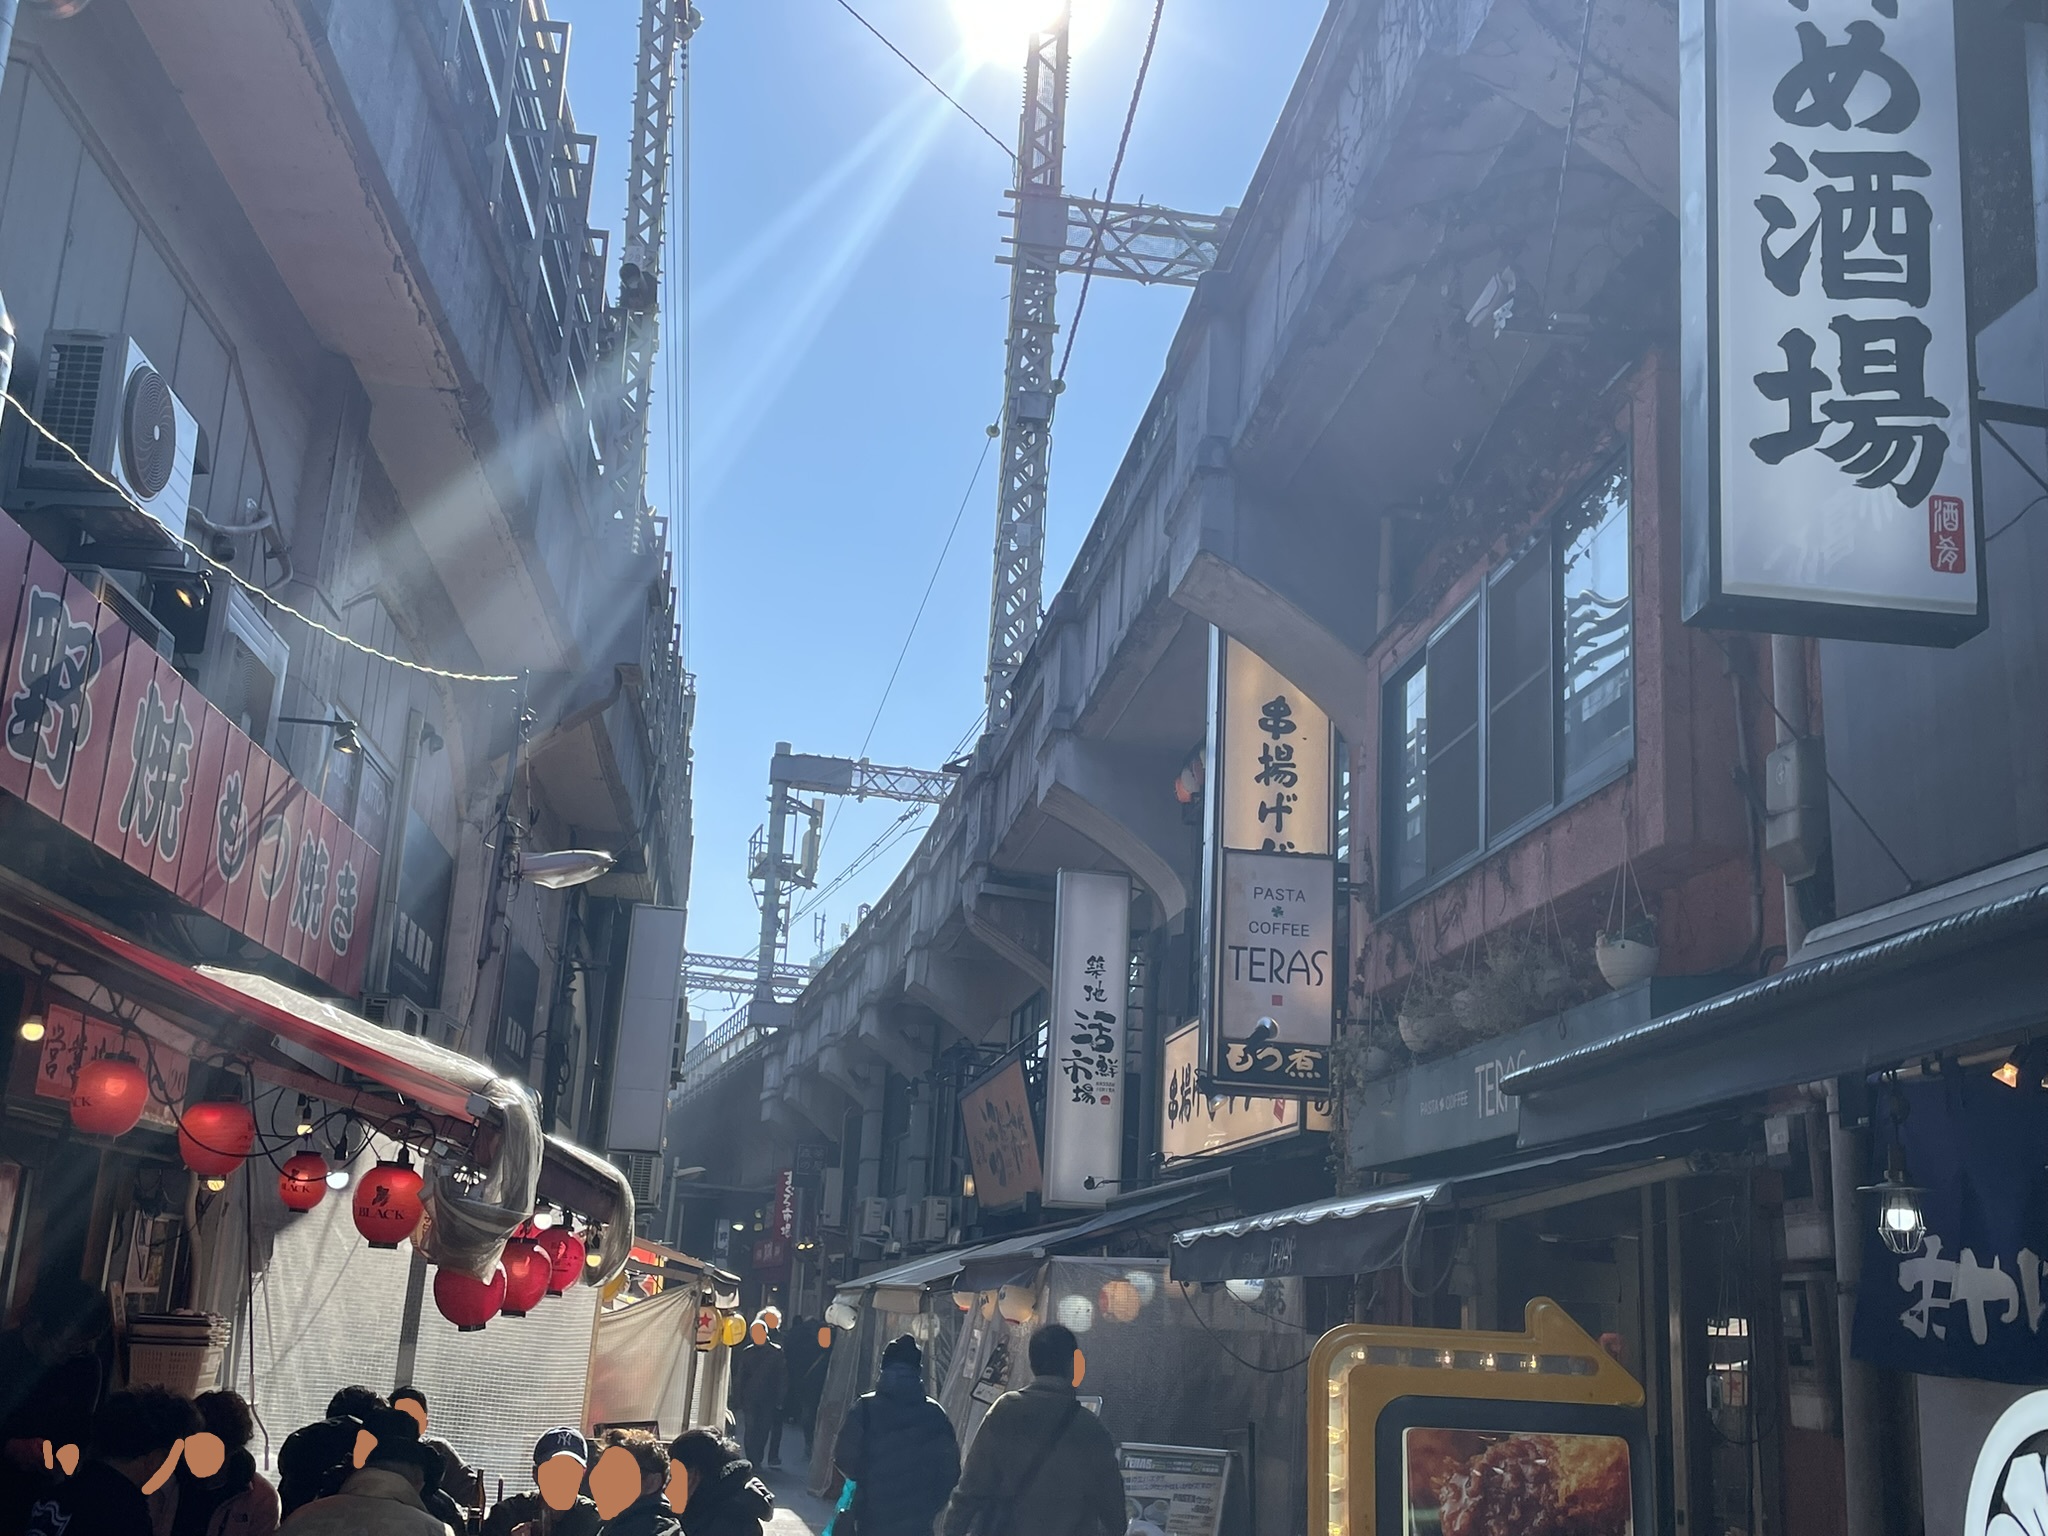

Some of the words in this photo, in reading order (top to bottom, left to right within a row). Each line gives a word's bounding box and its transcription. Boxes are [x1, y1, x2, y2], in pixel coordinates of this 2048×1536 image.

[1749, 0, 1951, 509] め酒場
[1254, 887, 1306, 902] PASTA
[1249, 921, 1310, 937] COFFEE
[1228, 945, 1329, 987] TERAS
[1226, 1043, 1323, 1079] もつ煮
[358, 1207, 404, 1220] BLACK
